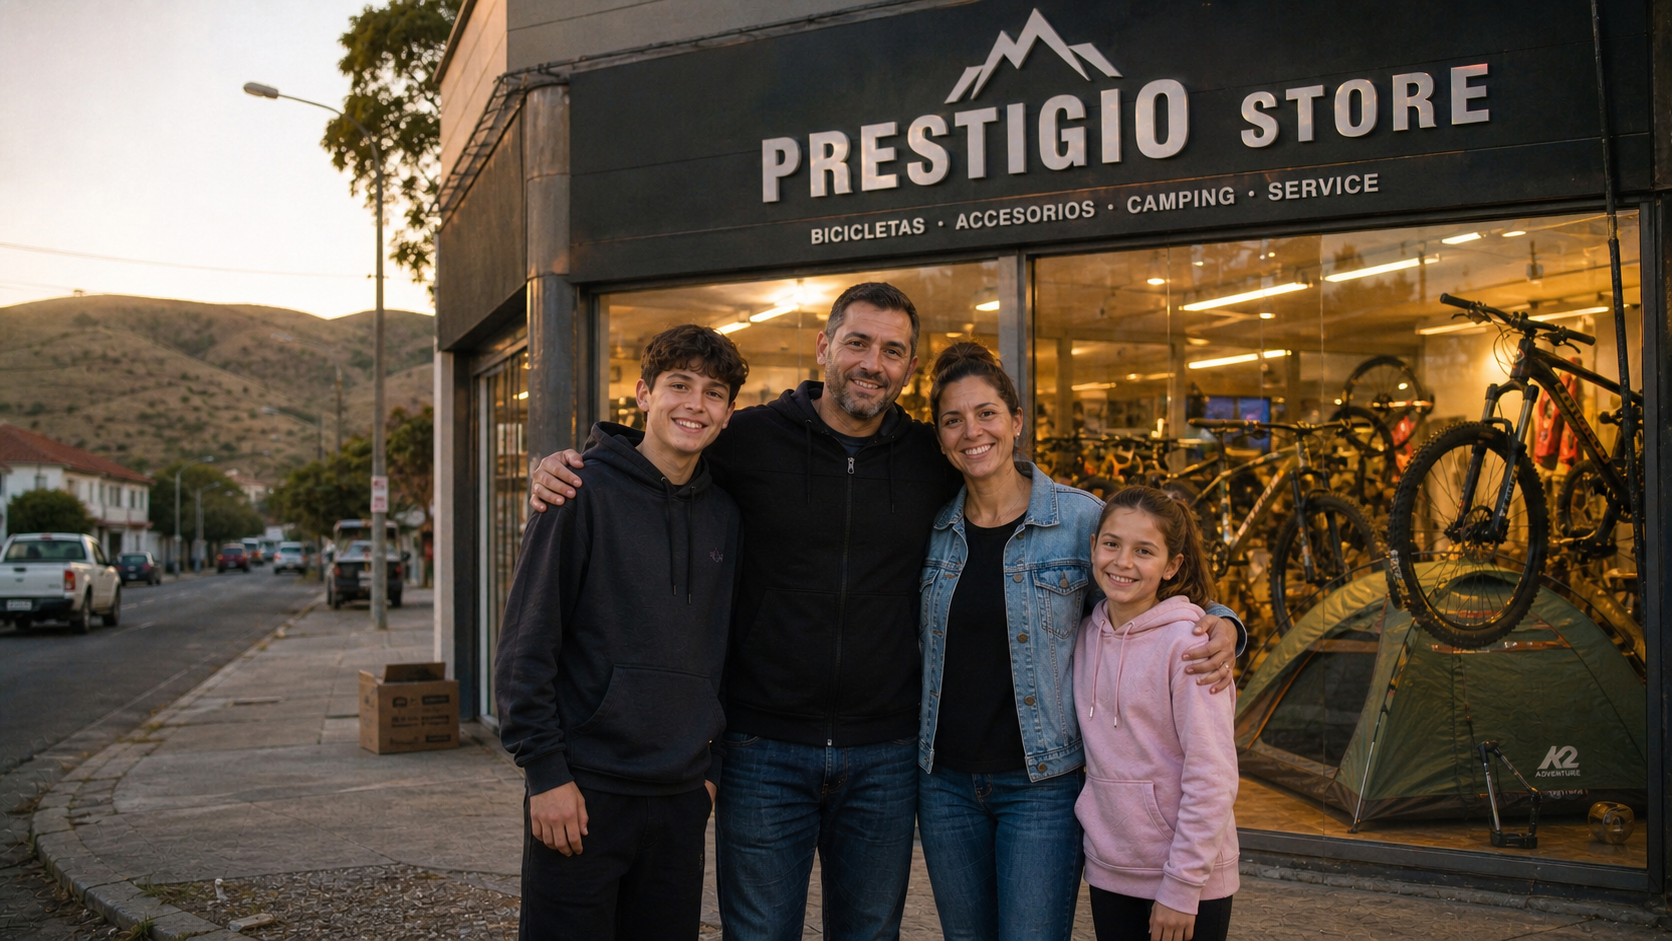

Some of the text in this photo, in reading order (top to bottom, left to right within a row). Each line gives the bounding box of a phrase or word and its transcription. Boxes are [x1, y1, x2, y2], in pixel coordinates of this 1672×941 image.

[762, 63, 1490, 203] PRESTIGIO STORE
[810, 173, 1380, 245] BICICLETAS ACCESORIOS CAMPING SERVICE
[1537, 745, 1580, 770] K2
